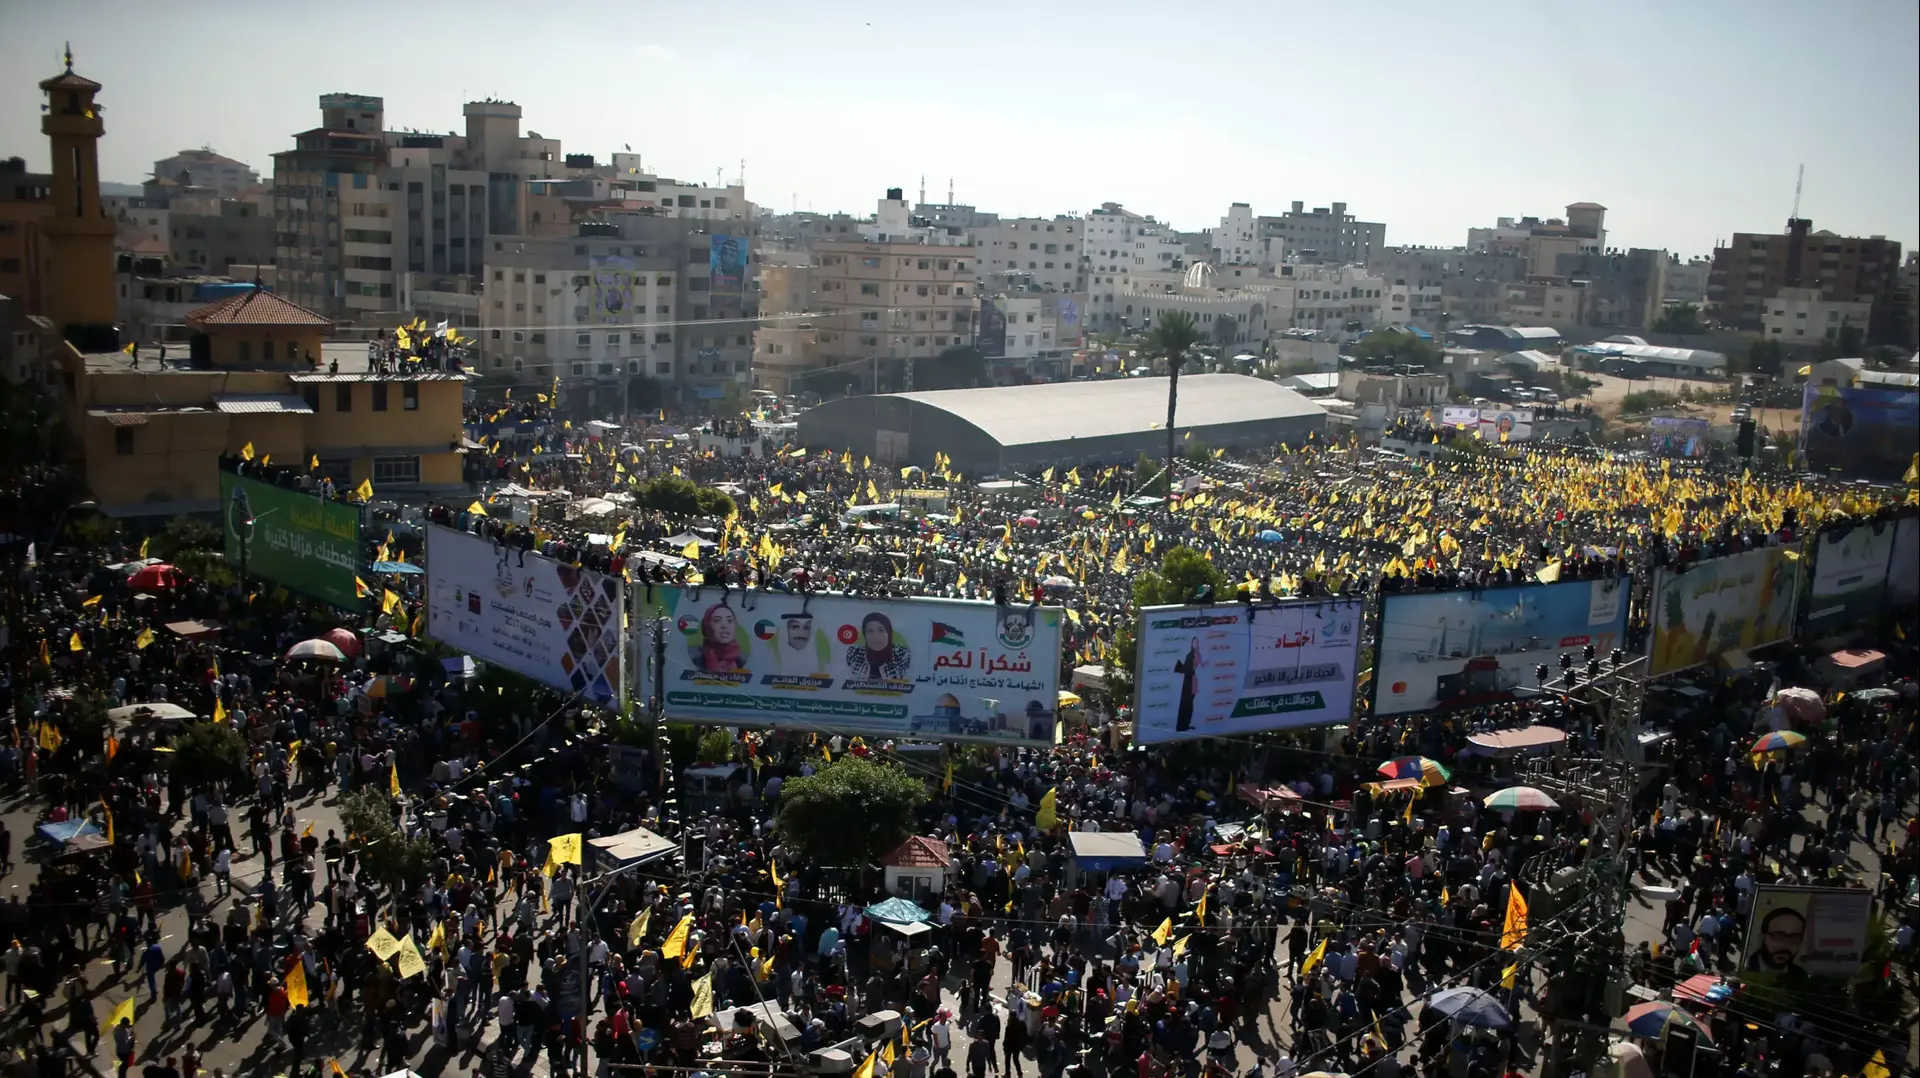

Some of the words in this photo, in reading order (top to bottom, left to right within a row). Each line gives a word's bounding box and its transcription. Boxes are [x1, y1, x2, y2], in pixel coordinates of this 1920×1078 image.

[290, 531, 312, 559] مزايا
[933, 650, 972, 671] لكم
[799, 679, 823, 687] مرزوق
[937, 675, 948, 687] من
[969, 677, 997, 688] تحتاج
[999, 678, 1005, 688] لا
[1007, 678, 1045, 690] الشهامة
[1245, 697, 1271, 710] عفتك
[1271, 696, 1284, 712] في
[1285, 693, 1316, 706] وجمالك
